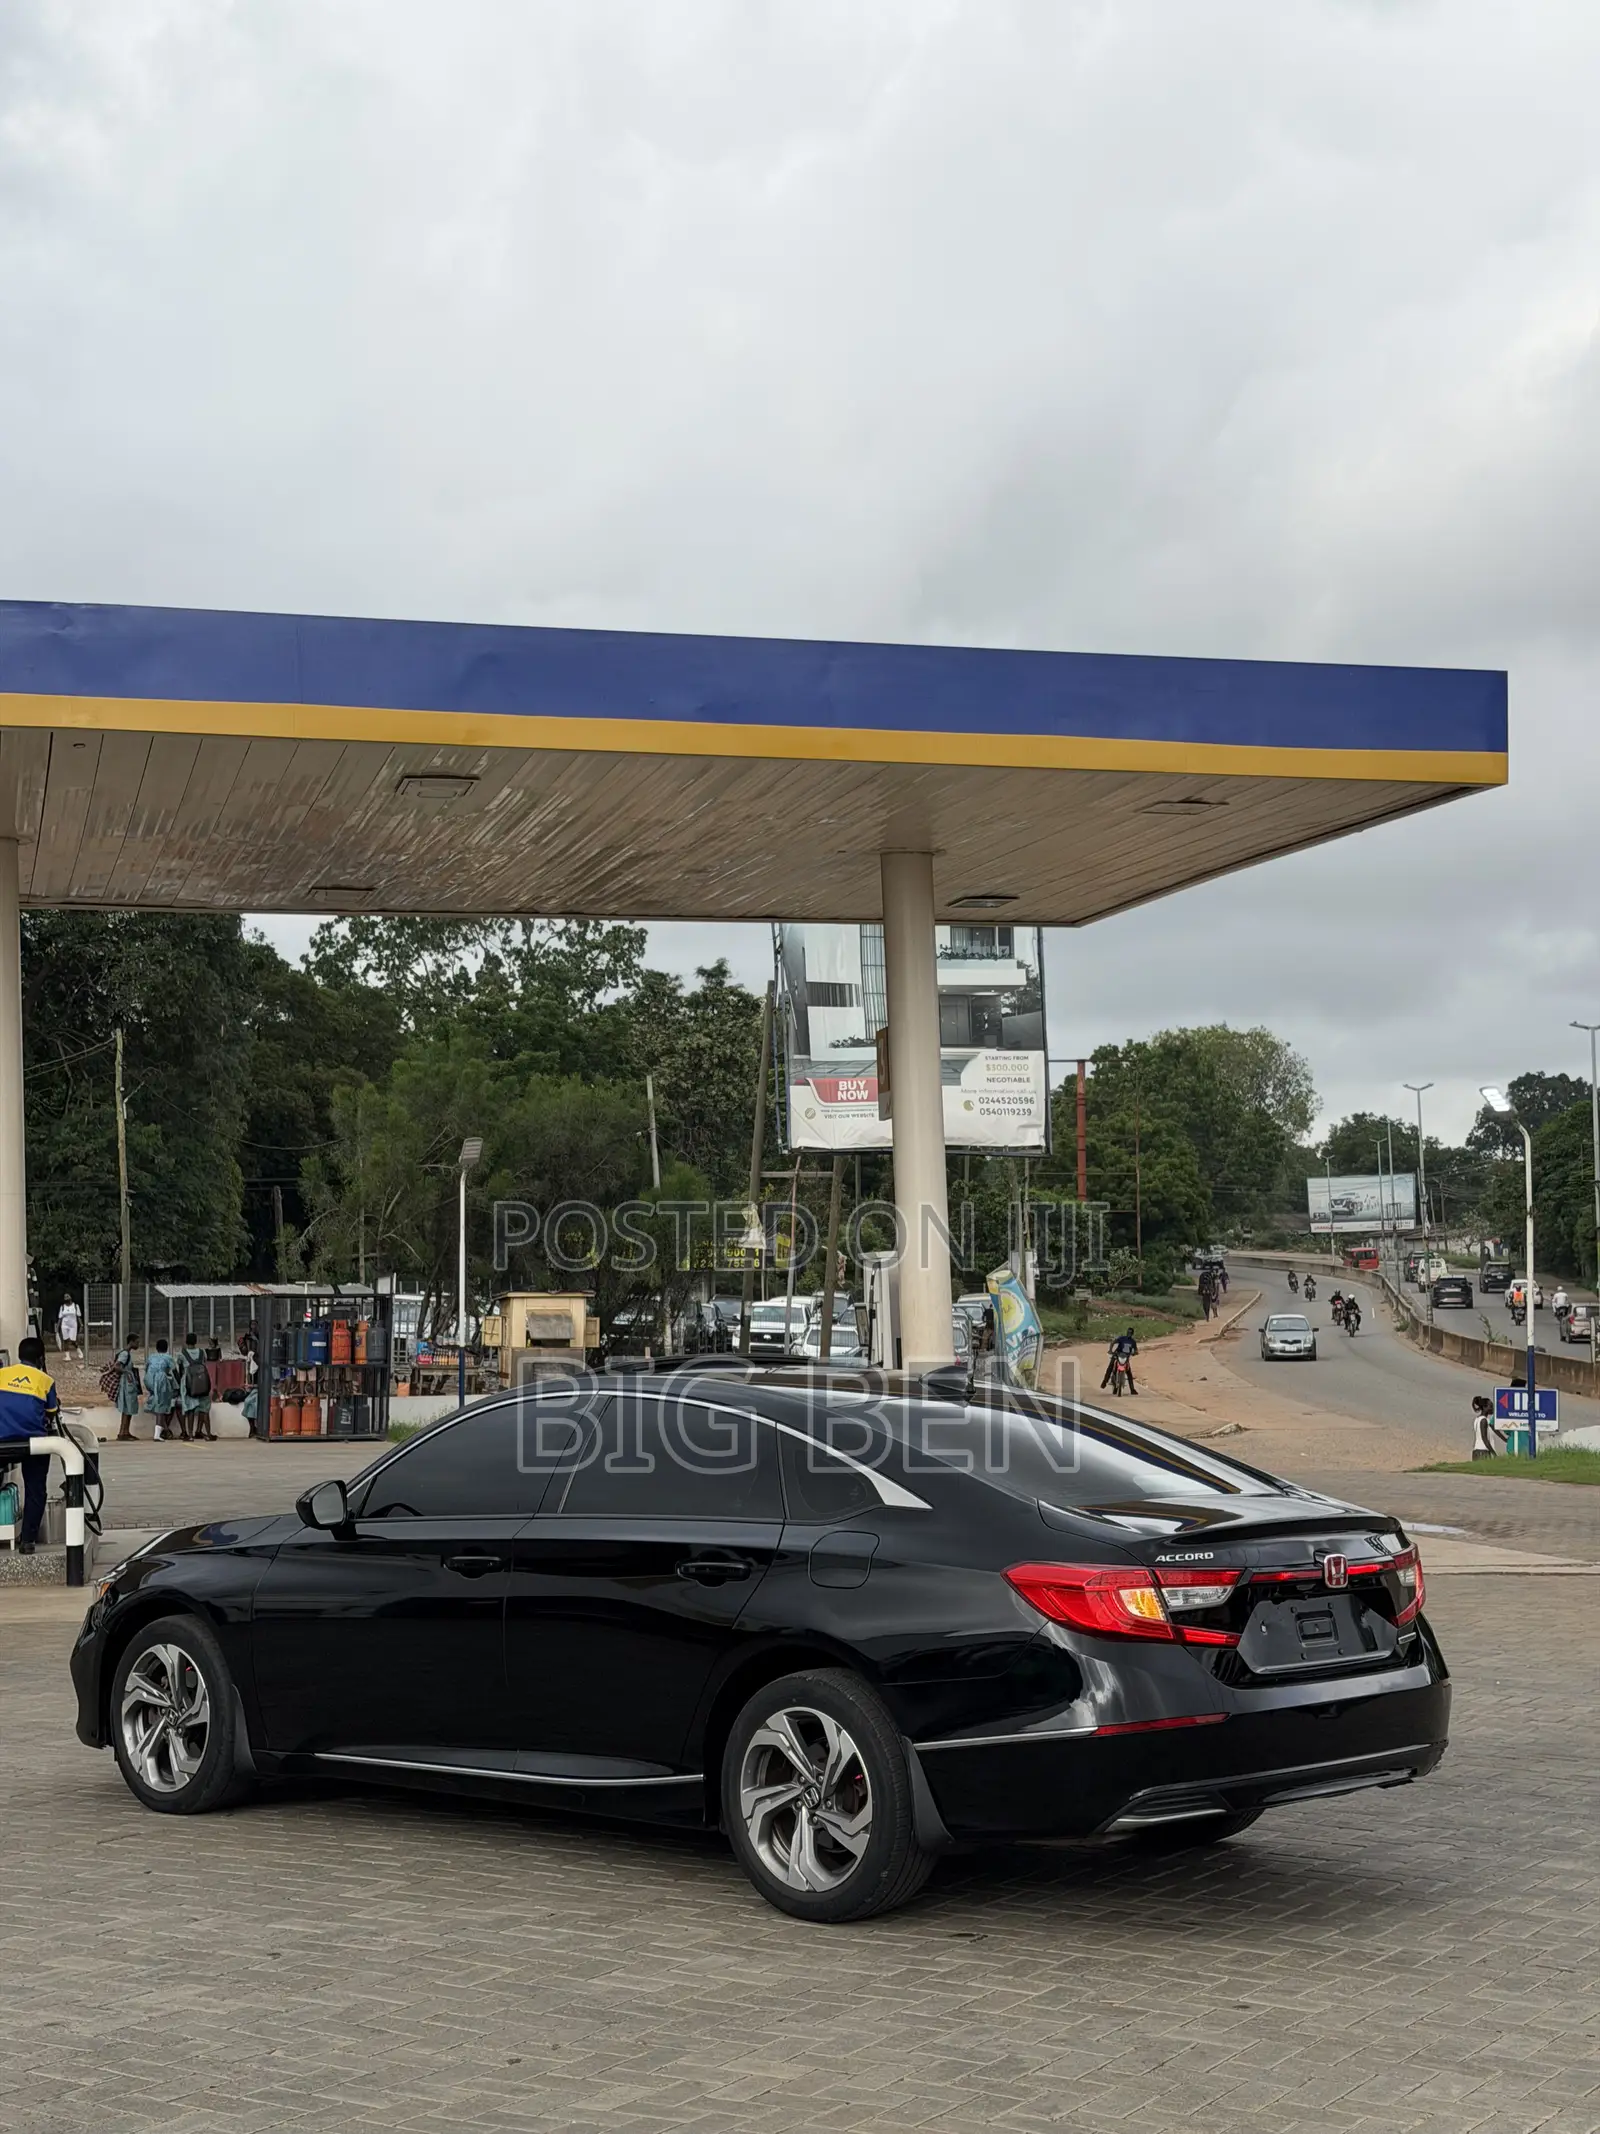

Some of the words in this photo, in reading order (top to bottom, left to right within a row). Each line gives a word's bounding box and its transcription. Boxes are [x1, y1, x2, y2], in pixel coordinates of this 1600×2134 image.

[838, 1079, 867, 1091] BUY
[837, 1089, 869, 1101] NOW
[978, 1096, 1035, 1105] 0244520596
[979, 1107, 1032, 1116] 0540119239
[1154, 1551, 1214, 1562] ACCORD
